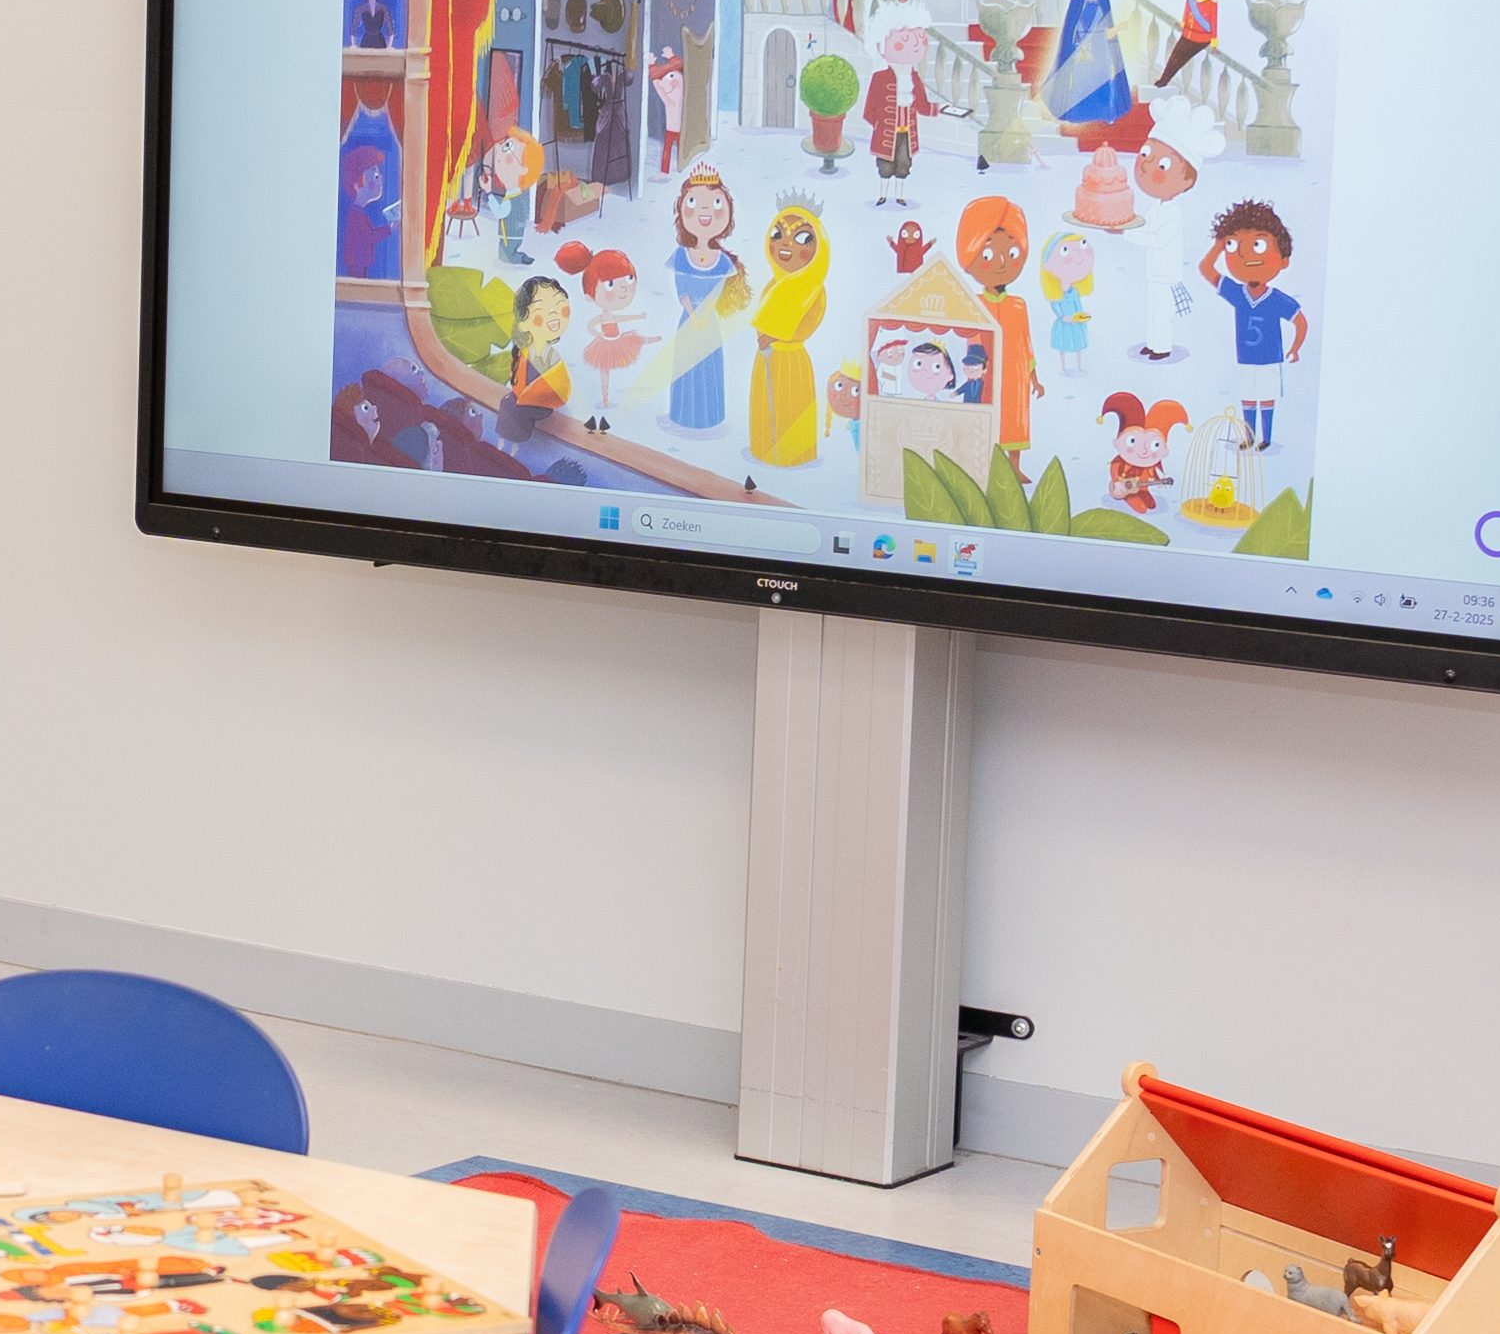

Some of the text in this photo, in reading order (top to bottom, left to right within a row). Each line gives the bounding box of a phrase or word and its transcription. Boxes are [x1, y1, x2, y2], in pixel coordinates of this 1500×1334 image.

[1245, 317, 1264, 347] 5
[662, 518, 702, 534] Zoeken
[756, 578, 798, 592] CTOUCH
[1463, 595, 1496, 608] 09:36
[1434, 609, 1495, 626] 27-2-2025
